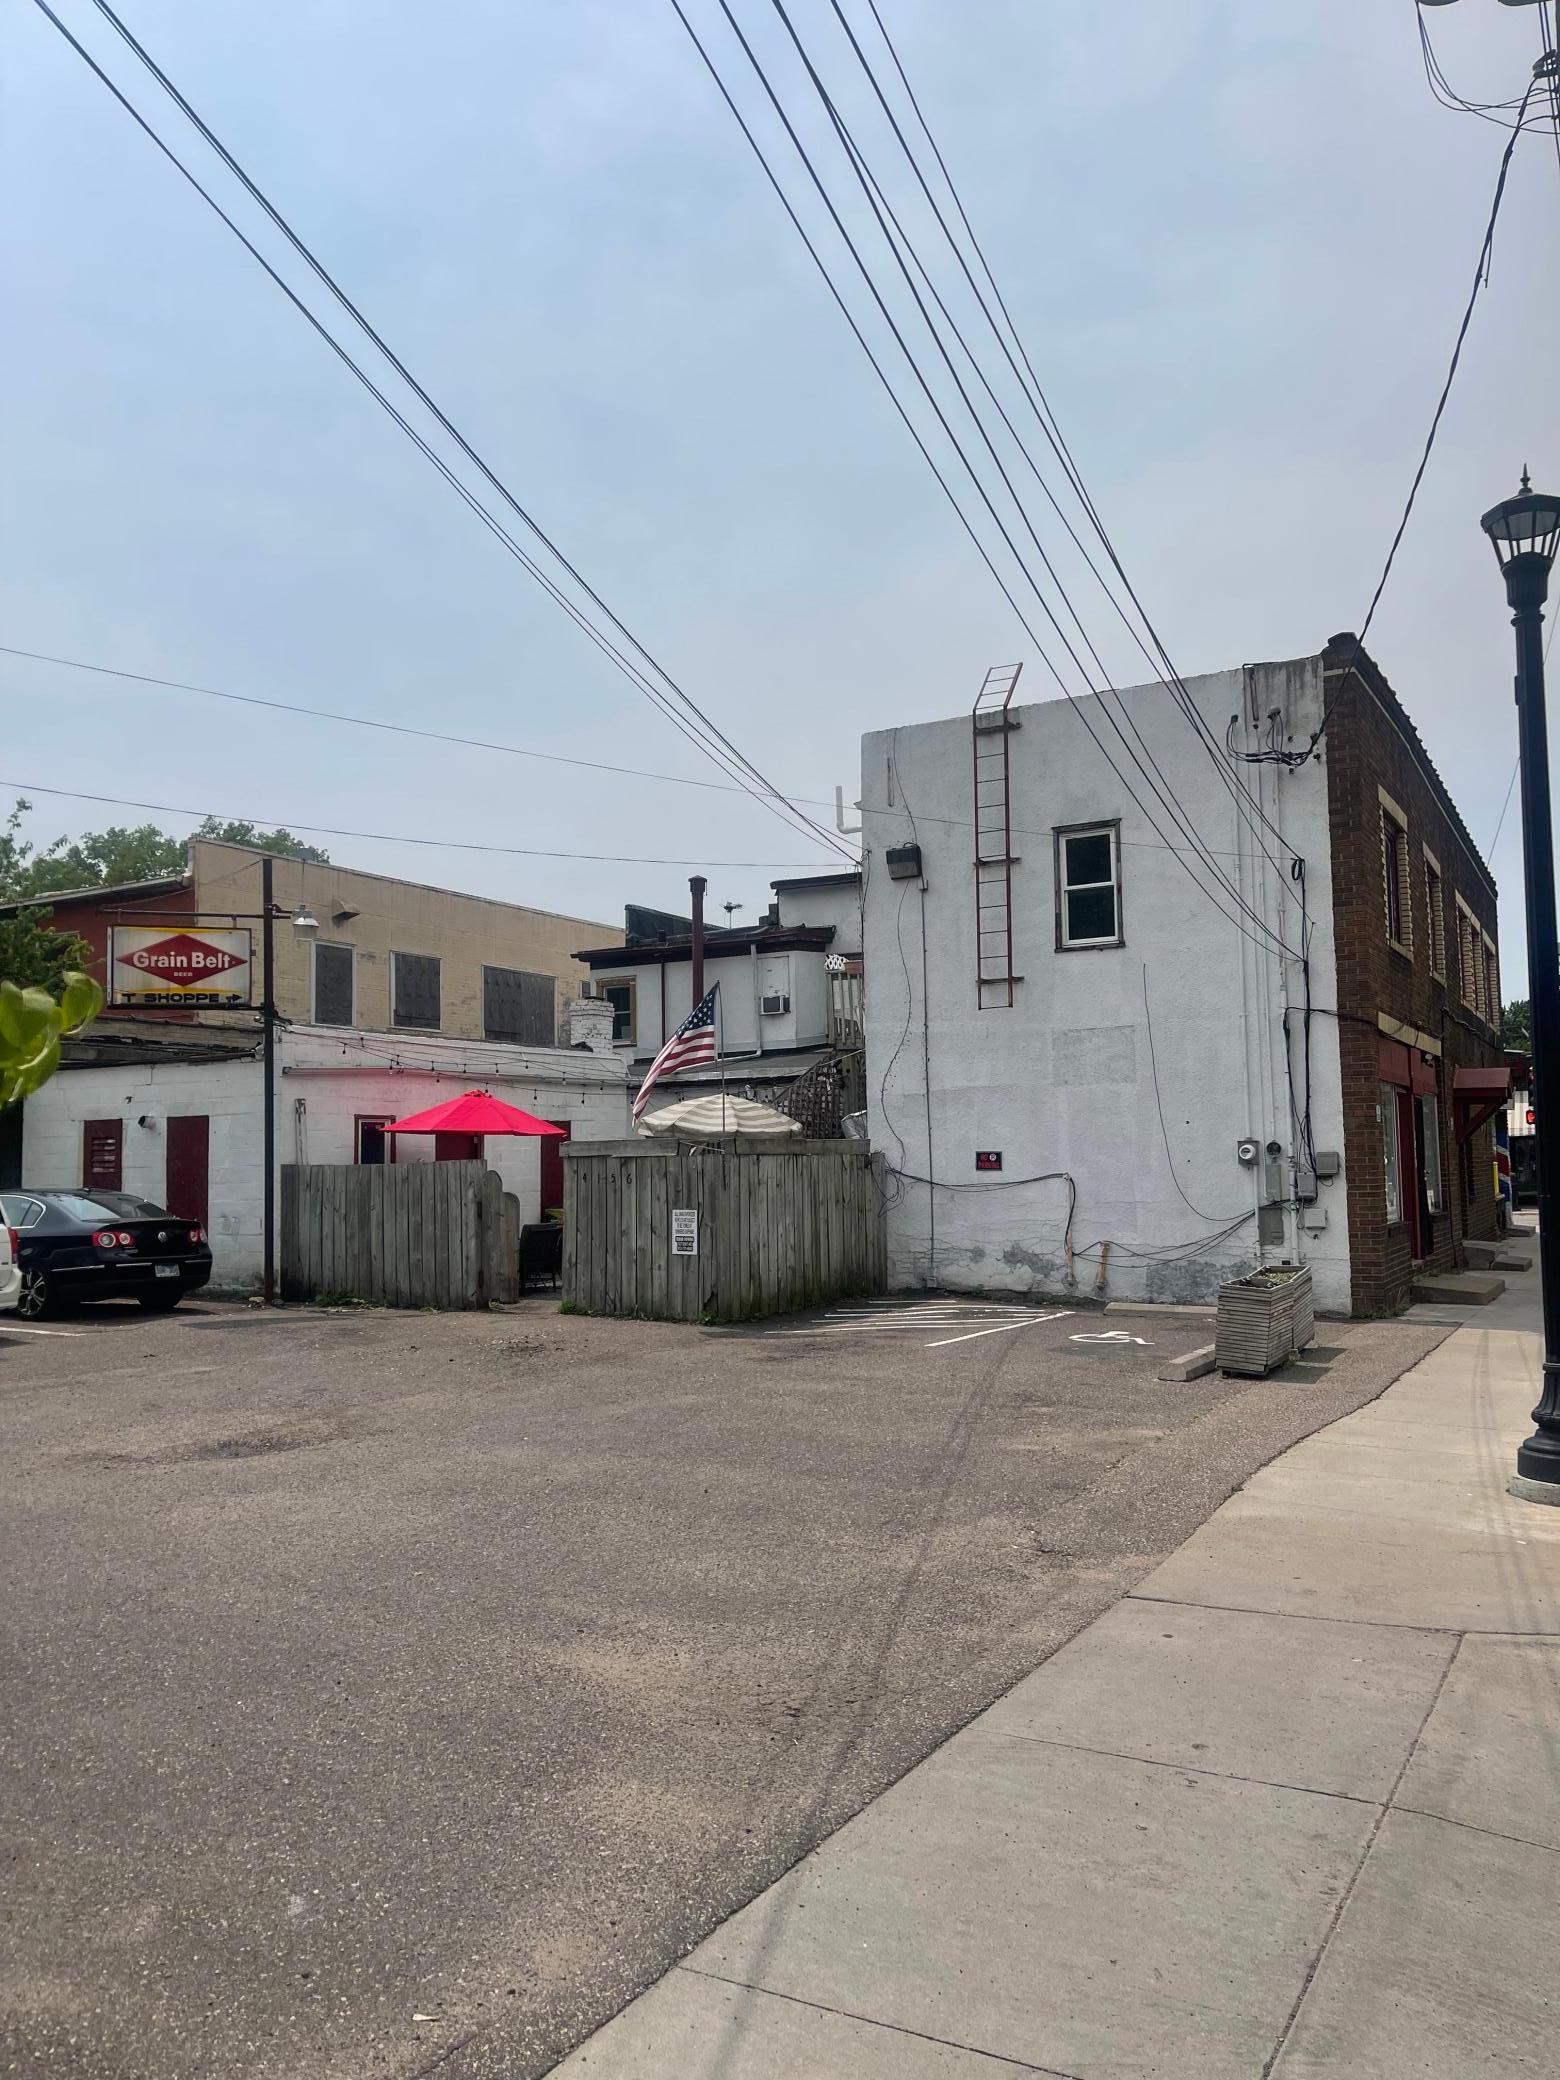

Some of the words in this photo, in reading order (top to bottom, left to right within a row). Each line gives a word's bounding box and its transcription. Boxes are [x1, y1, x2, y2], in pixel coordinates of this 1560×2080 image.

[132, 951, 188, 968] Grain
[191, 952, 230, 969] Belt
[143, 993, 220, 1003] SHOPPE
